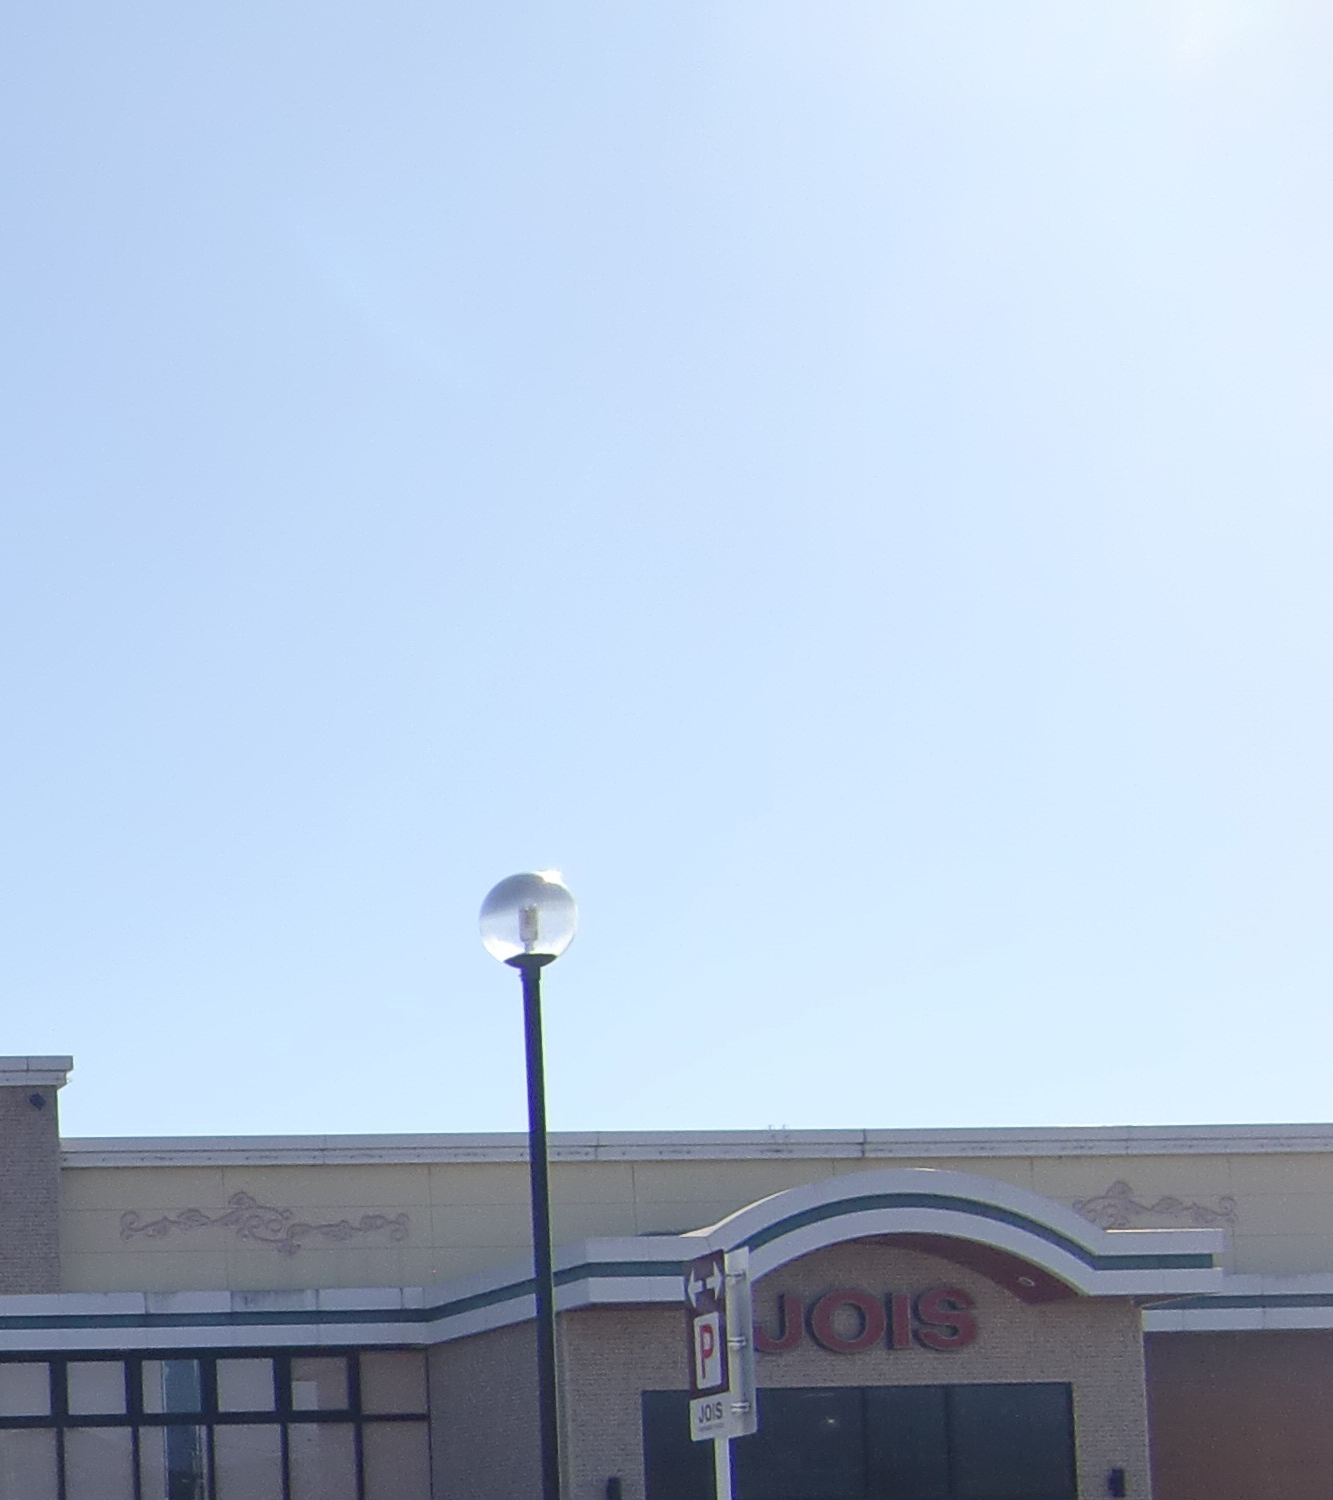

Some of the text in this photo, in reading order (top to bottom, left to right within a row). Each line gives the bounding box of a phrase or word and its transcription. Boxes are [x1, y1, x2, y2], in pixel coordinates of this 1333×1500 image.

[753, 1287, 979, 1352] JOIS
[699, 1323, 715, 1380] P
[698, 1402, 724, 1424] JOIS
